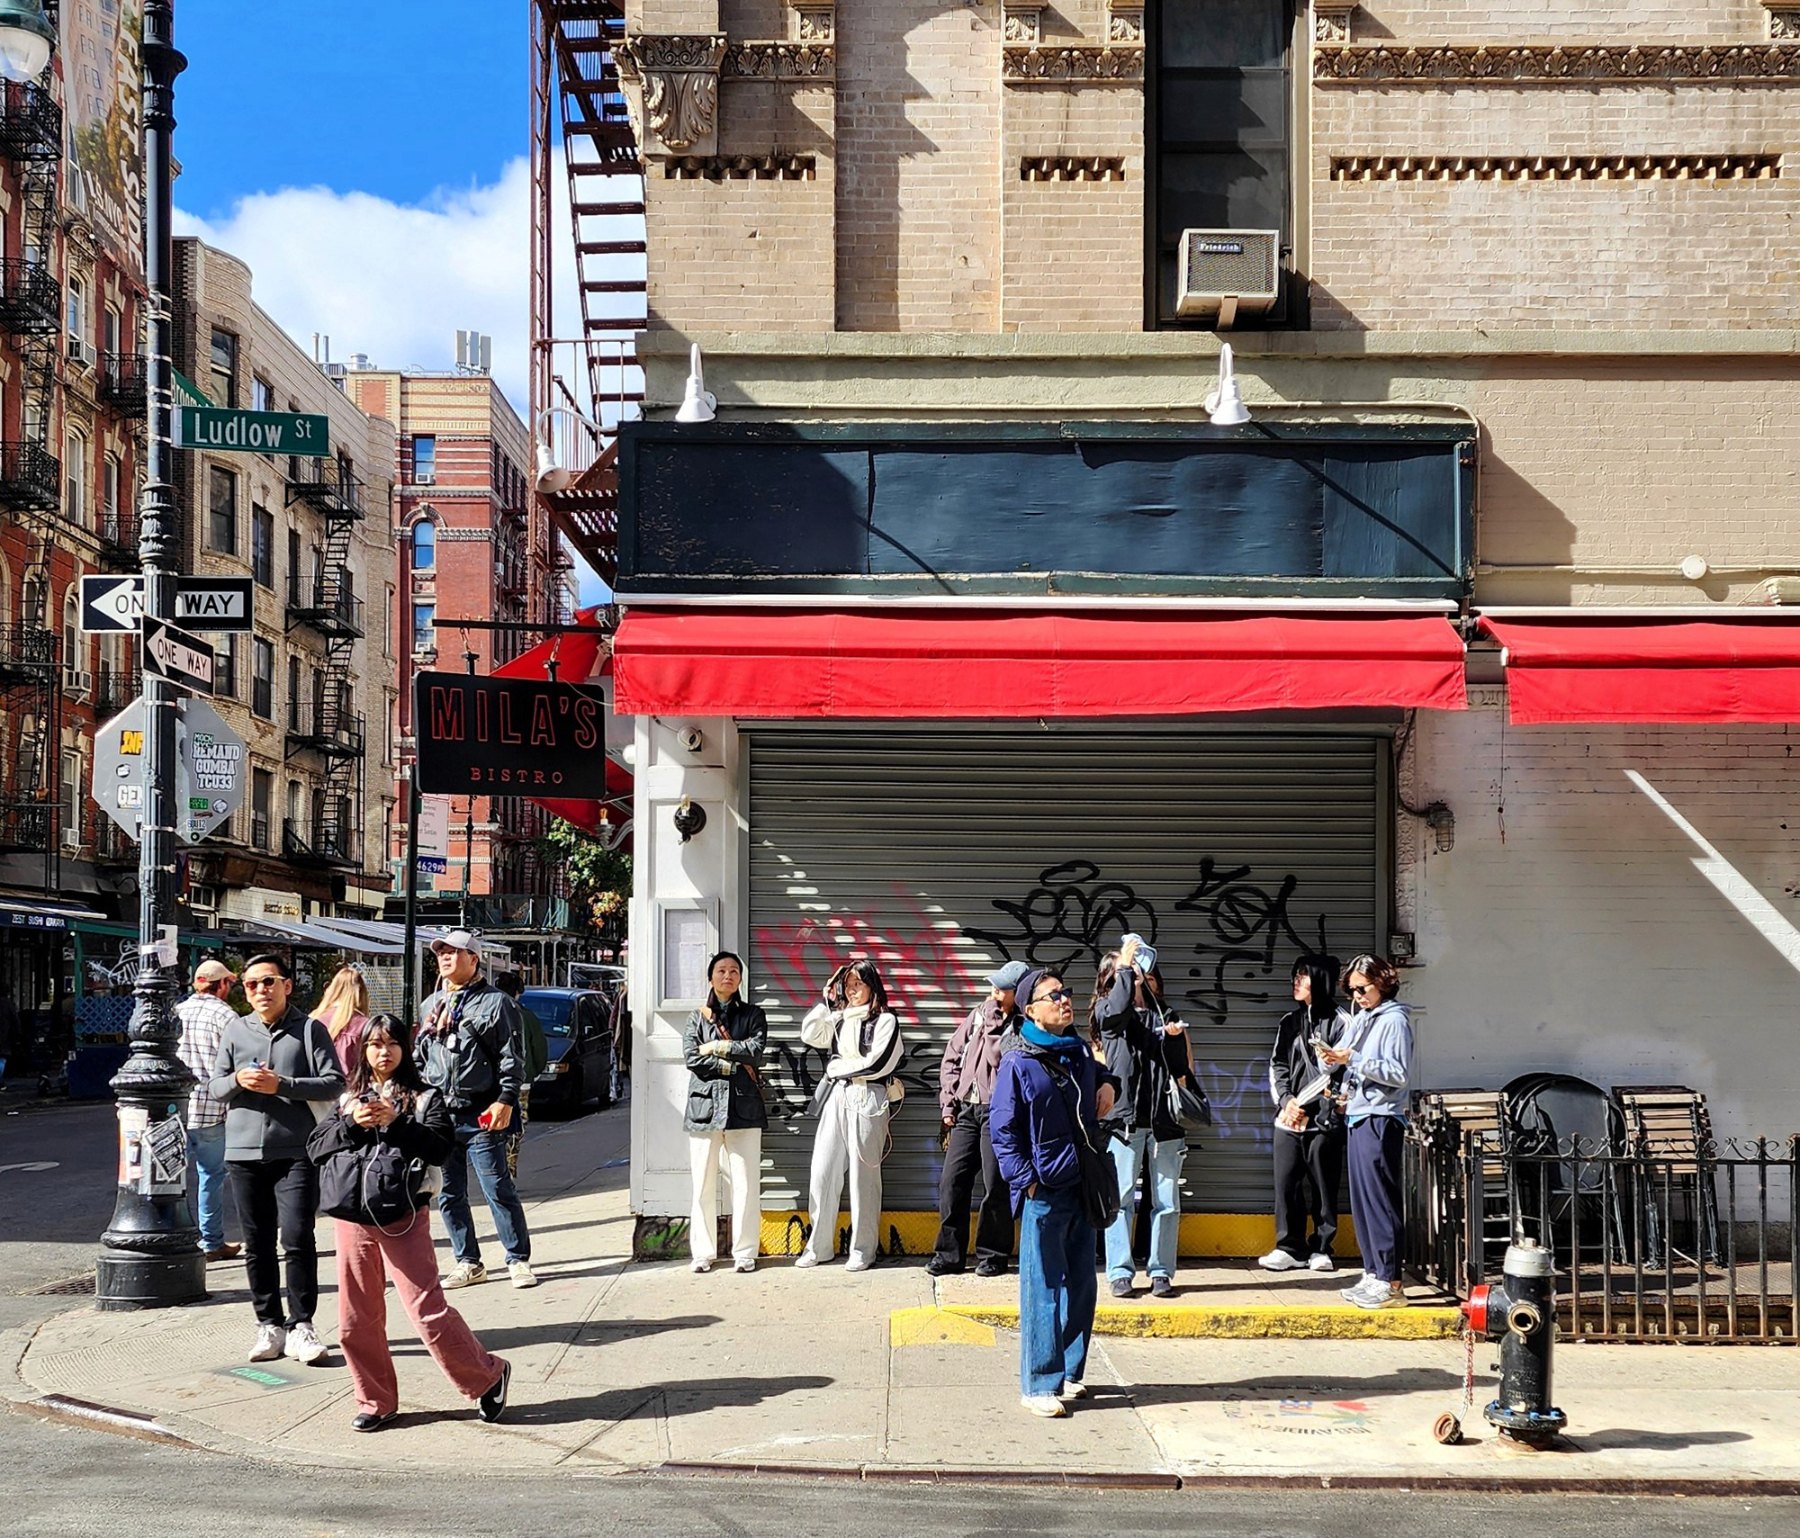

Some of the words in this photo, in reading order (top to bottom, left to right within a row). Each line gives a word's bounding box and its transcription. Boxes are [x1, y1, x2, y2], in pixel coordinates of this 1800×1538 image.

[117, 27, 140, 157] EAST
[120, 158, 145, 276] SIDE
[194, 412, 282, 448] Ludlow
[295, 418, 312, 438] St
[115, 594, 145, 614] ON
[184, 593, 235, 615] WAY
[157, 638, 178, 666] ONE
[186, 650, 208, 679] WAY
[430, 685, 598, 749] MILA'S
[469, 766, 564, 785] BISTRO
